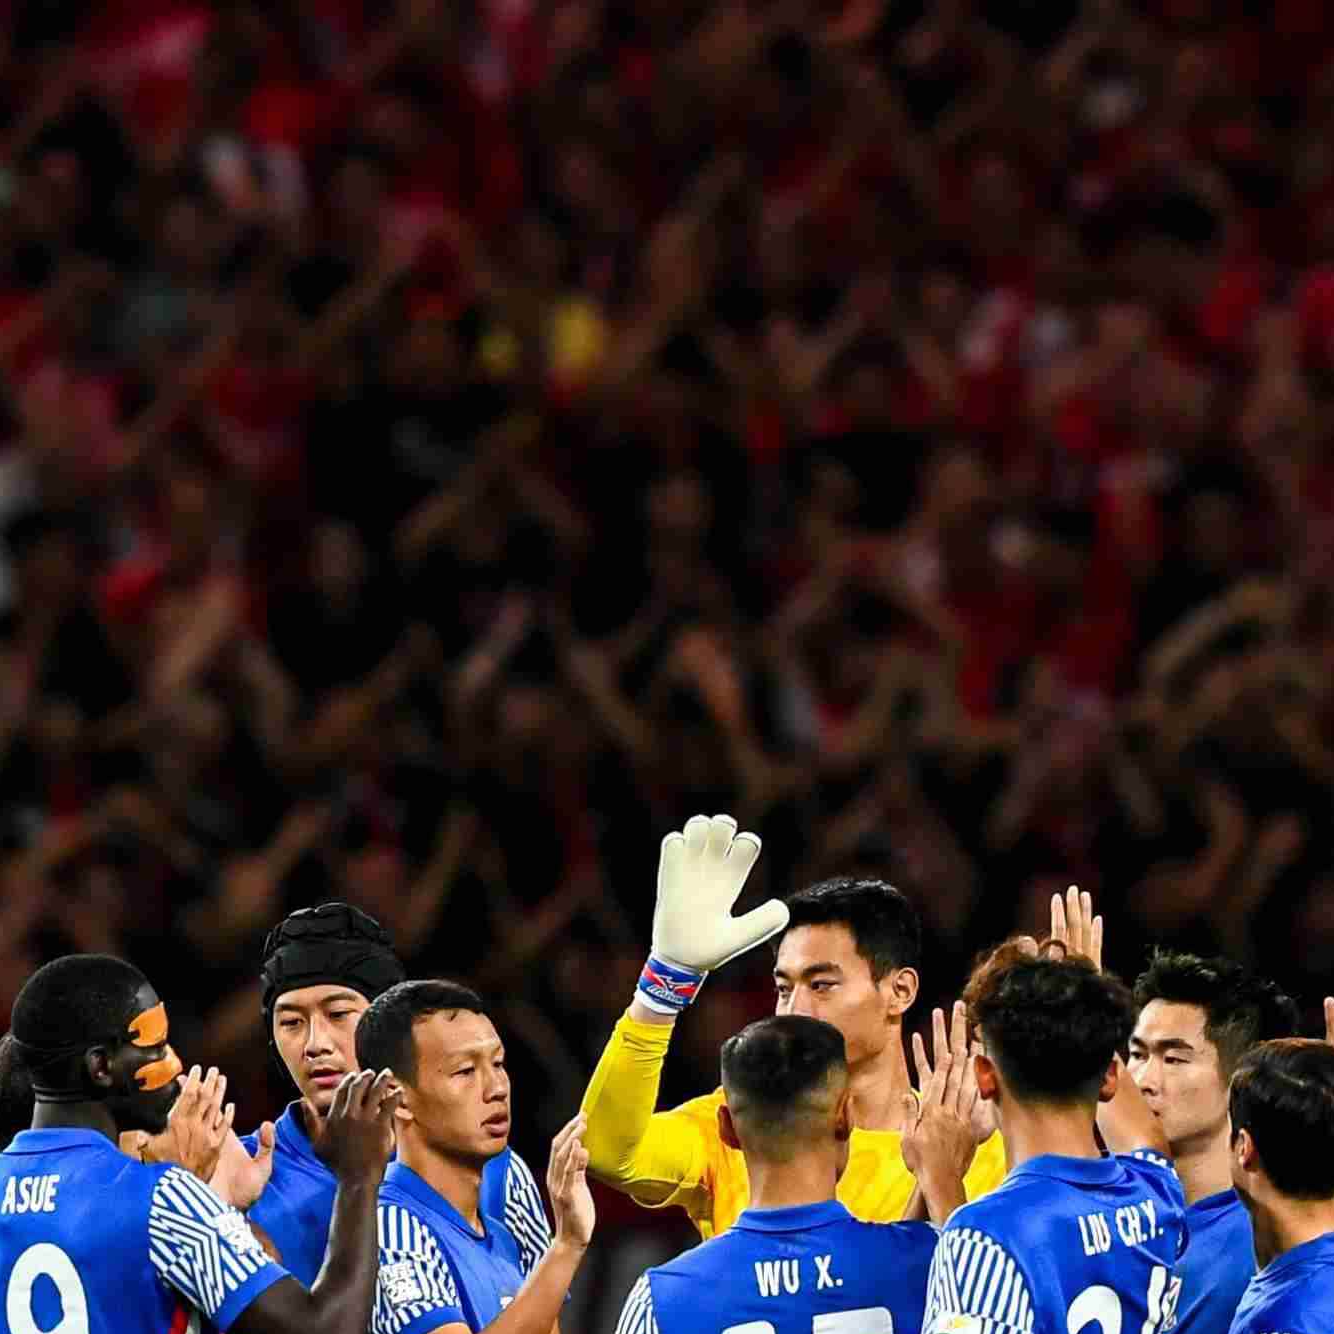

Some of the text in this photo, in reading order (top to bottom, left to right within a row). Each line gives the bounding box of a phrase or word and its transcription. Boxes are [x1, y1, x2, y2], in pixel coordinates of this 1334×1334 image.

[1, 1173, 60, 1215] ASUE
[1078, 1212, 1112, 1257] LIU
[754, 1255, 844, 1297] WU X.
